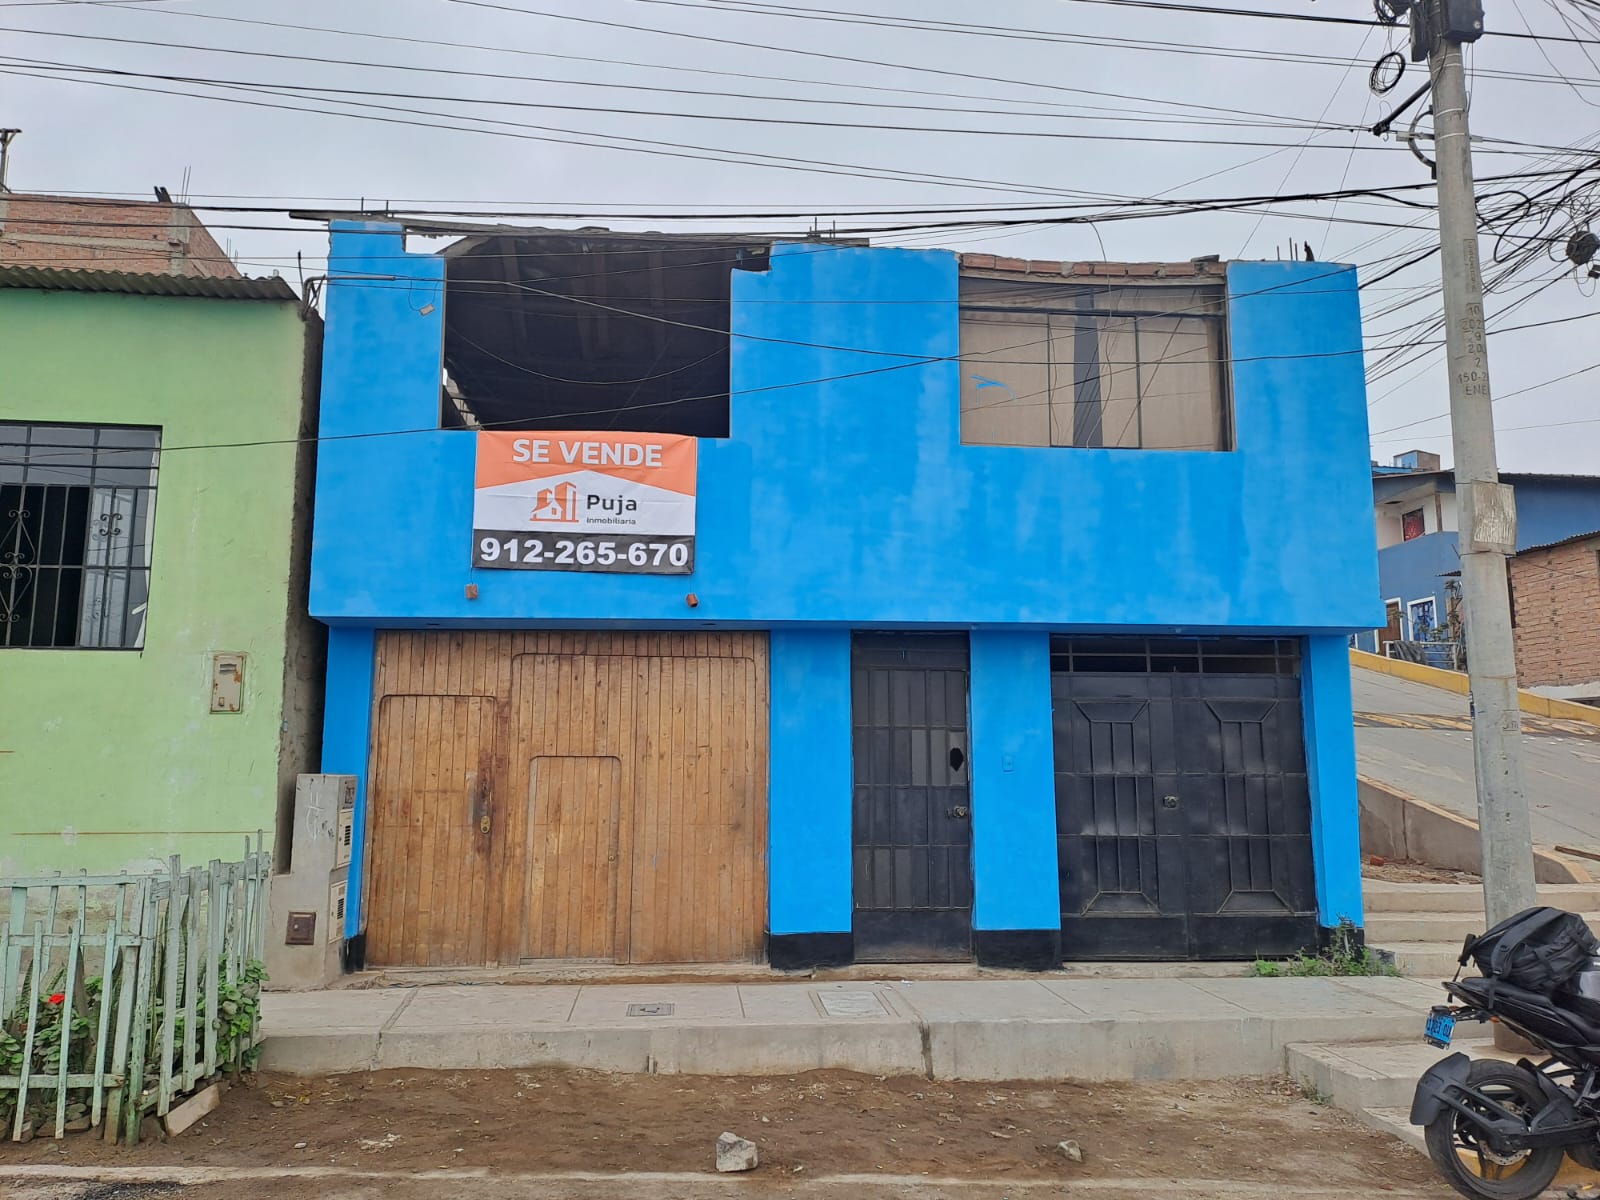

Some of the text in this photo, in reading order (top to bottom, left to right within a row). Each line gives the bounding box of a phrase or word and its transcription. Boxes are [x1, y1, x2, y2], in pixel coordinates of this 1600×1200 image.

[512, 439, 663, 467] SE VENDE
[586, 494, 637, 516] Puja
[480, 537, 689, 567] 912-265-670
